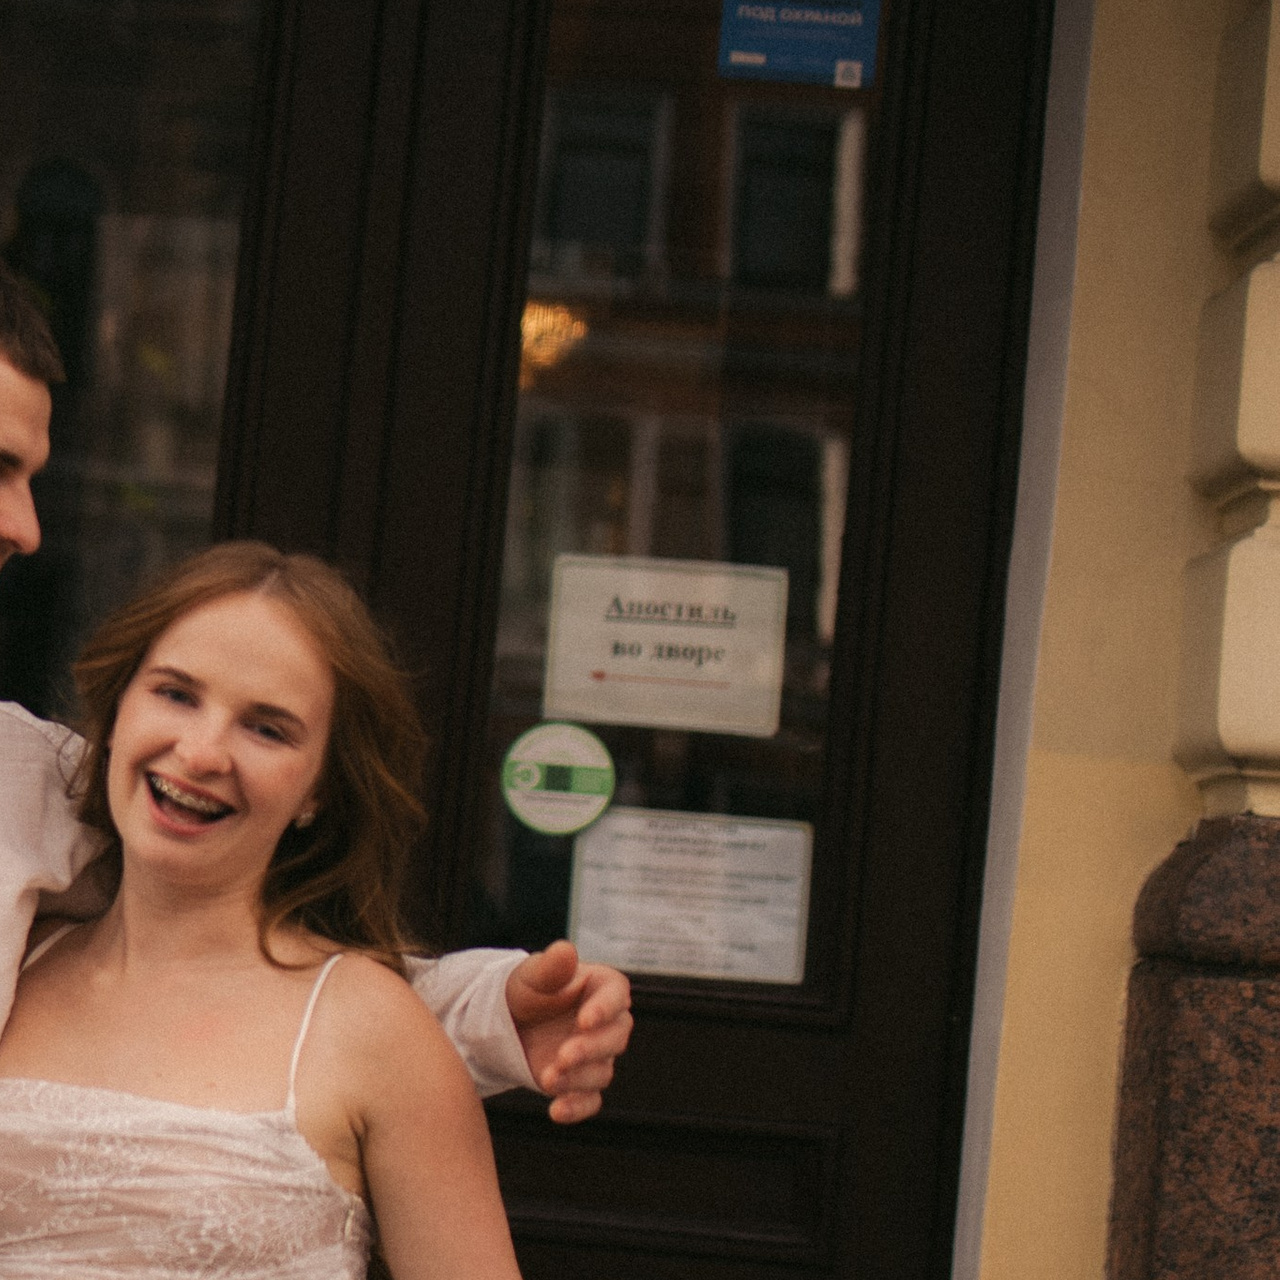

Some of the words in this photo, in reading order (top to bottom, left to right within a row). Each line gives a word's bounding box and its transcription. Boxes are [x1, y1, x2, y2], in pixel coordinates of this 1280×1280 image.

[737, 5, 776, 22] ПОД
[606, 594, 736, 622] Апостиль
[611, 640, 642, 656] во
[650, 642, 725, 667] дворе
